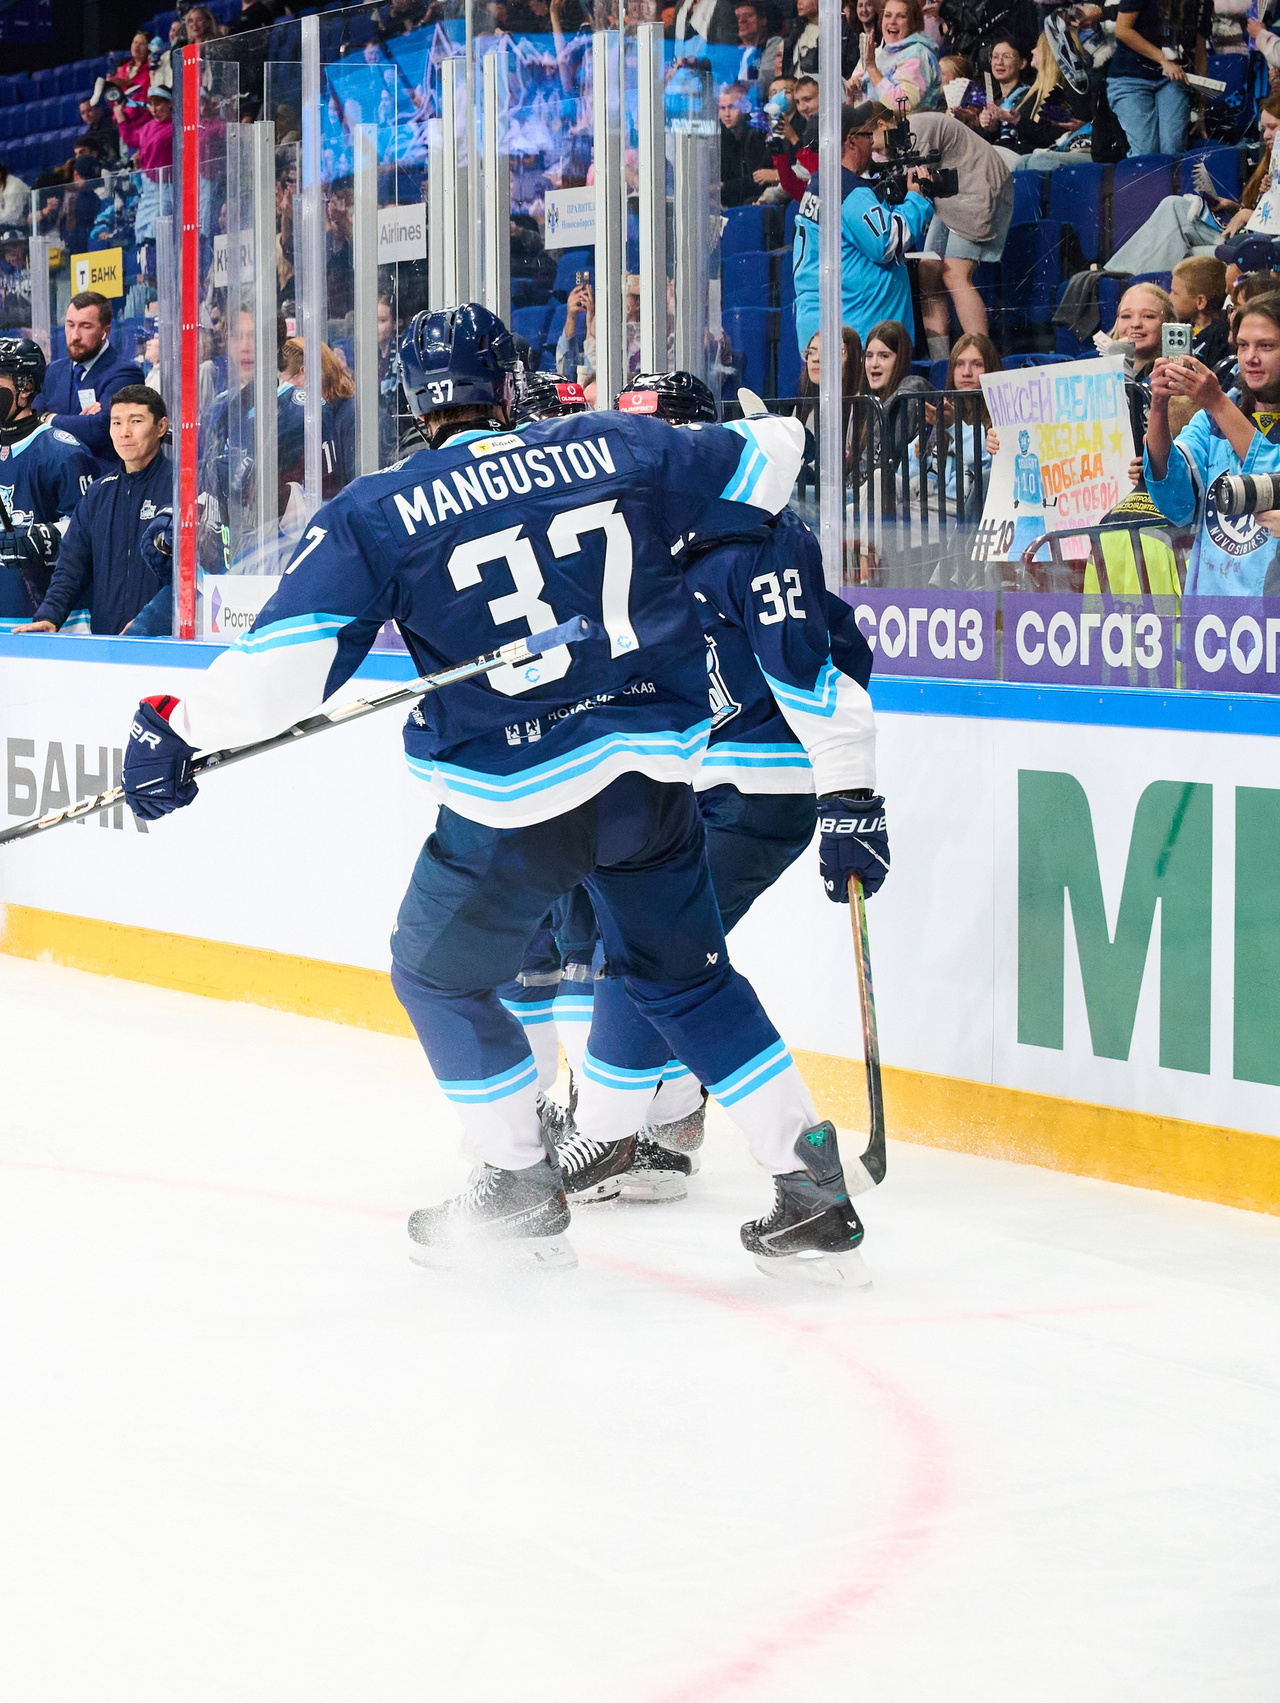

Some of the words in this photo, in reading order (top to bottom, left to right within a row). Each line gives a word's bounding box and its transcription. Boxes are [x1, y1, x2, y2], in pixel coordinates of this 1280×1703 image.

[380, 222, 423, 246] Airlines
[862, 205, 888, 238] 17
[91, 265, 117, 284] БАНК
[427, 380, 454, 404] 37
[987, 371, 1053, 427] АЛЕКСЕЙ
[1035, 422, 1105, 465] ЗВЕЗДА
[393, 437, 618, 537] MANGUSTOV
[1040, 452, 1104, 499] ПОБЕДА
[1074, 475, 1119, 515] ТОБОЙ
[284, 525, 328, 575] 7
[972, 518, 1015, 562] #10
[1209, 526, 1269, 556] NOVOSIBIRSK
[224, 606, 261, 629] Росте
[446, 498, 640, 697] 37
[751, 568, 807, 626] 32
[1194, 614, 1280, 676] сог
[6, 736, 150, 834] БАНК
[820, 817, 887, 835] BAUE
